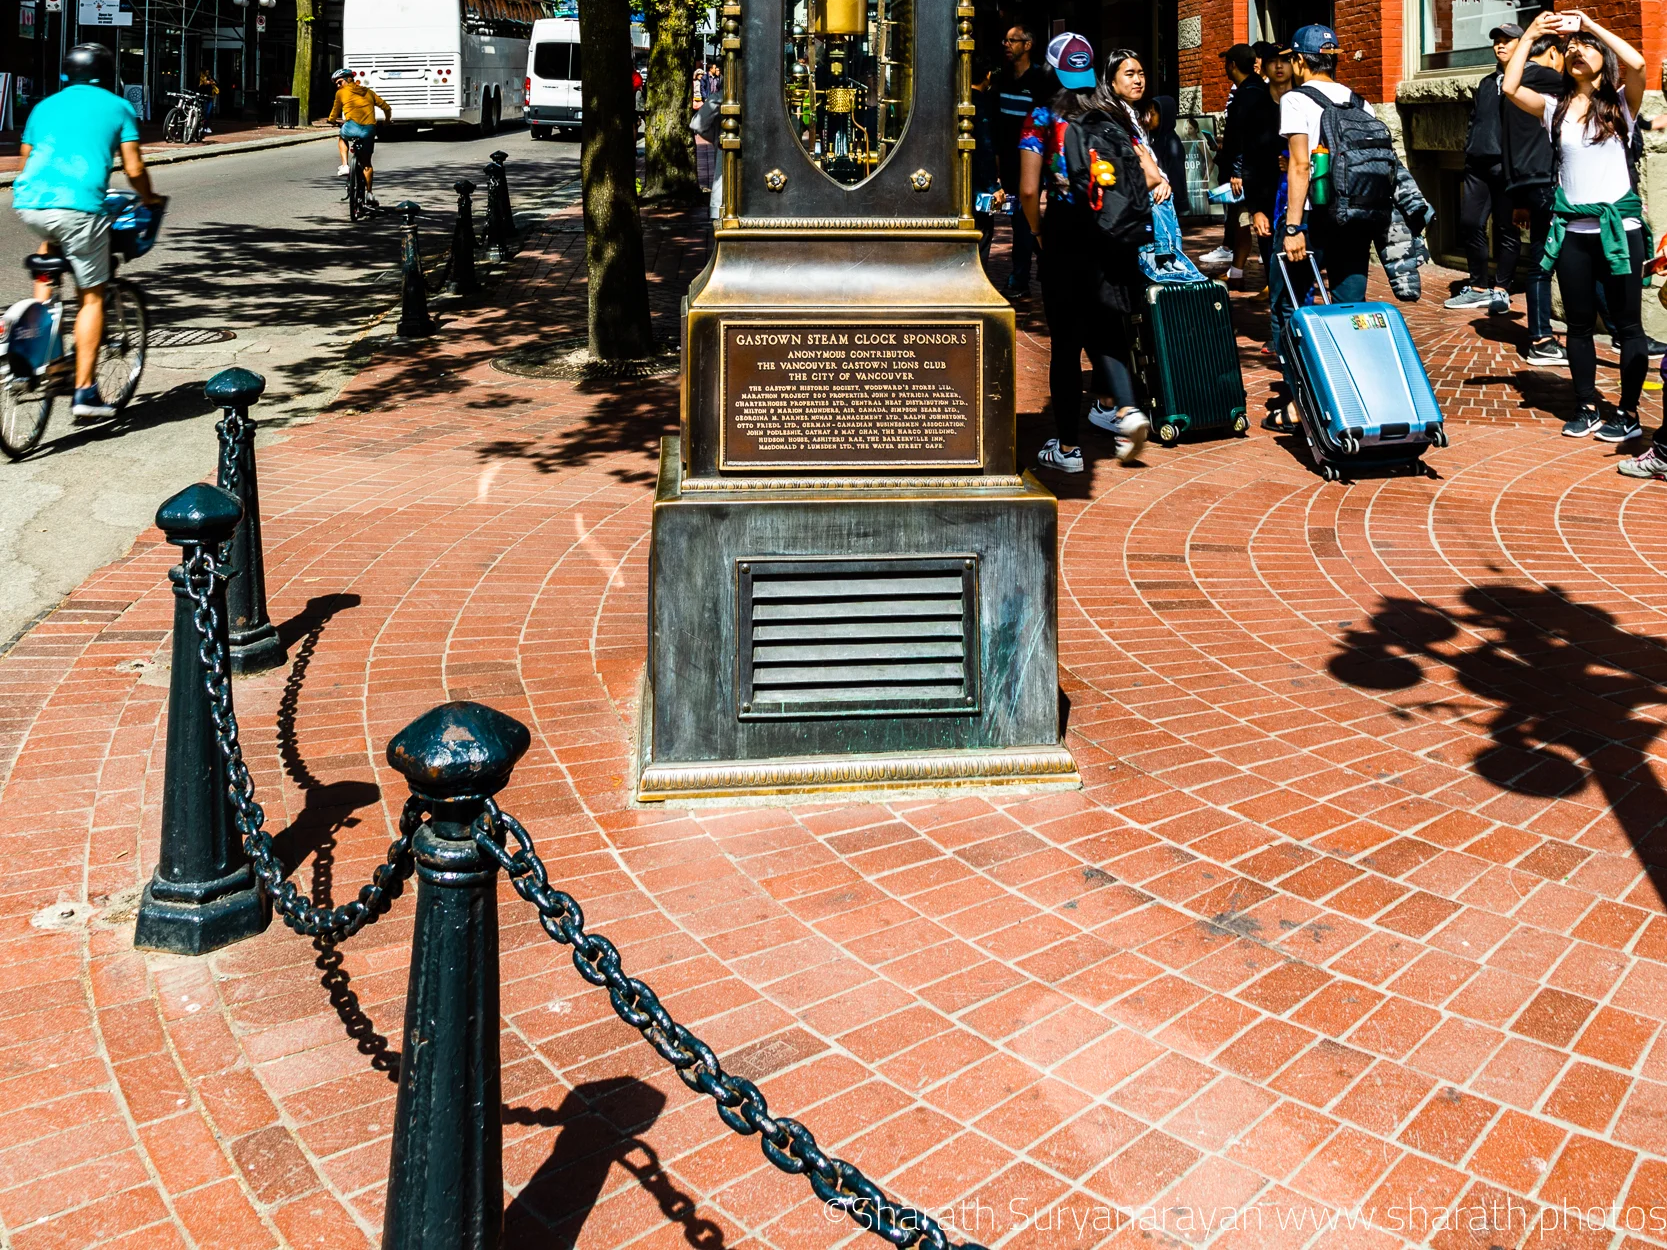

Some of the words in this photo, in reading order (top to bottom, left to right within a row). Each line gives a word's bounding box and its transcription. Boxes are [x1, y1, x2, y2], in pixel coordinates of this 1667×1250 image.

[736, 334, 802, 345] GASTOWN
[807, 334, 849, 345] STEAM
[854, 333, 897, 345] CLOCK
[903, 333, 967, 344] SPONSORS
[787, 350, 846, 359] ANONYMOUS
[850, 350, 916, 358] CONTRIBUTOR
[757, 362, 776, 370] THE
[779, 361, 838, 370] VANCOUVER
[842, 361, 888, 369] GASTOWN
[892, 361, 919, 369] LIONS
[923, 360, 947, 369] CLUB
[788, 373, 808, 381] THE
[811, 372, 835, 381] CITY
[839, 372, 851, 380] OF
[855, 372, 915, 380] VANCOUVER
[829, 392, 870, 400] PROPERTIES,
[805, 407, 841, 415] SAUNDERS,
